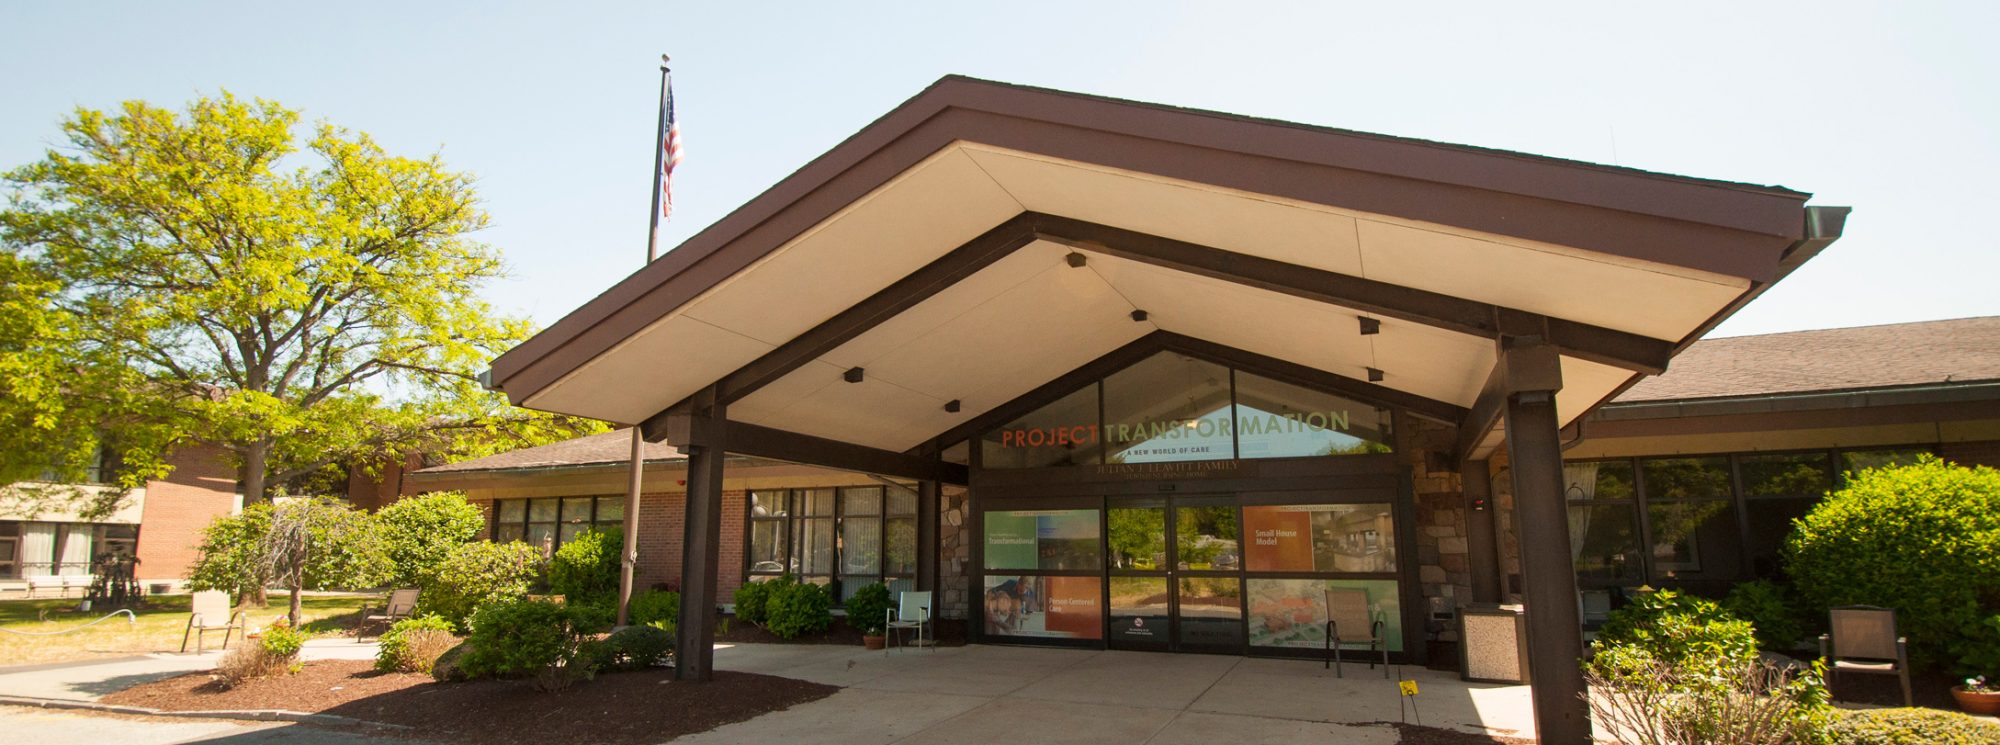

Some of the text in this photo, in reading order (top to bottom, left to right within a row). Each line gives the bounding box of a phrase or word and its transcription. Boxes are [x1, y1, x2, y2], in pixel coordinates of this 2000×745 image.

[1003, 410, 1350, 448] PROJECT TRANSFORMATION
[1149, 463, 1194, 473] LEAVITT
[1197, 460, 1240, 471] FAMILY
[1255, 529, 1297, 537] Small House
[1256, 537, 1278, 545] Model
